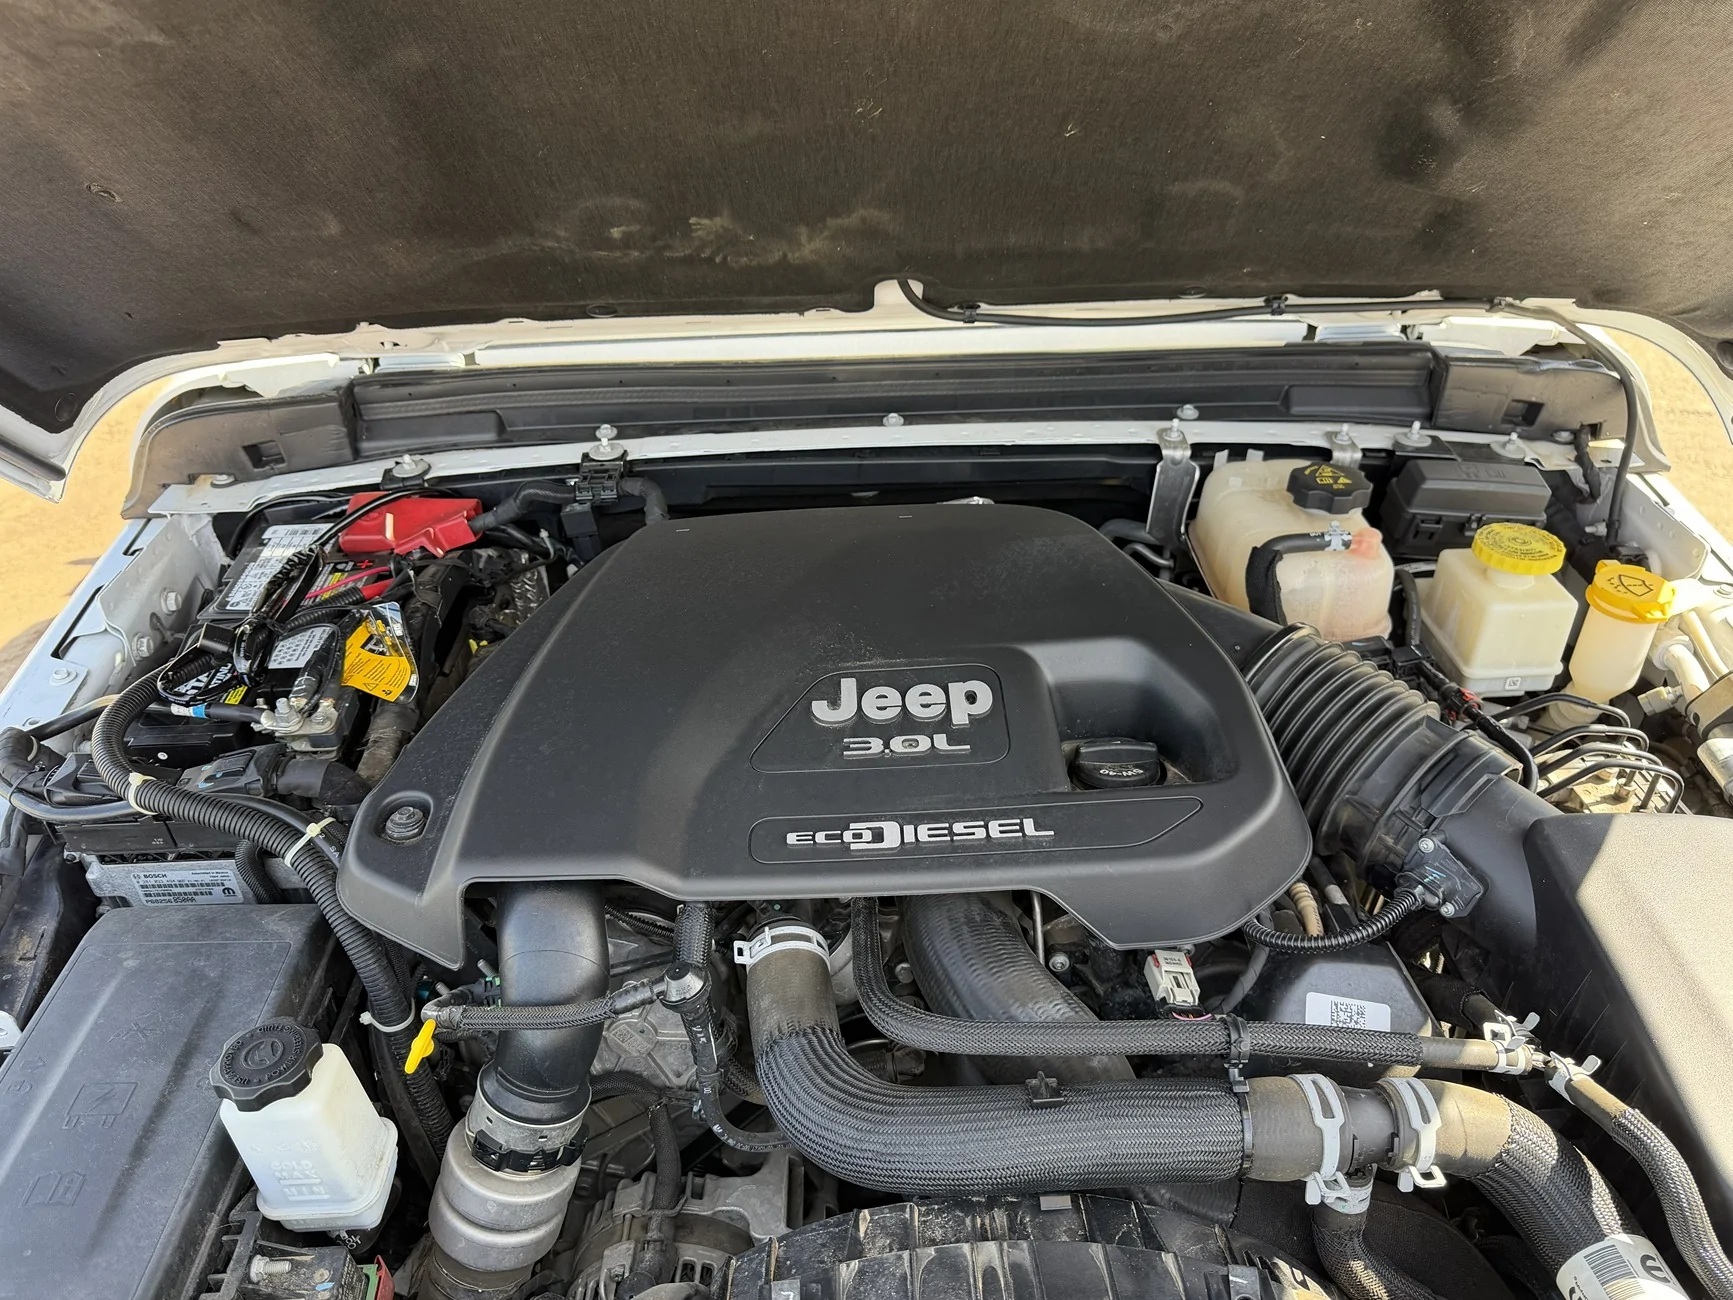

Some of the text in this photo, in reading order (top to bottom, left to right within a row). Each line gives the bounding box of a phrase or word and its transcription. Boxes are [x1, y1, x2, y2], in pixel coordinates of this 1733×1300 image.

[811, 677, 993, 727] Jeep
[843, 734, 971, 758] 3.0L
[1100, 768, 1144, 777] 5W-40
[266, 1054, 298, 1080] POWER
[283, 1025, 303, 1055] STEERING
[271, 1160, 313, 1171] COLD
[274, 1170, 318, 1180] MAX
[283, 1185, 326, 1196] MIN
